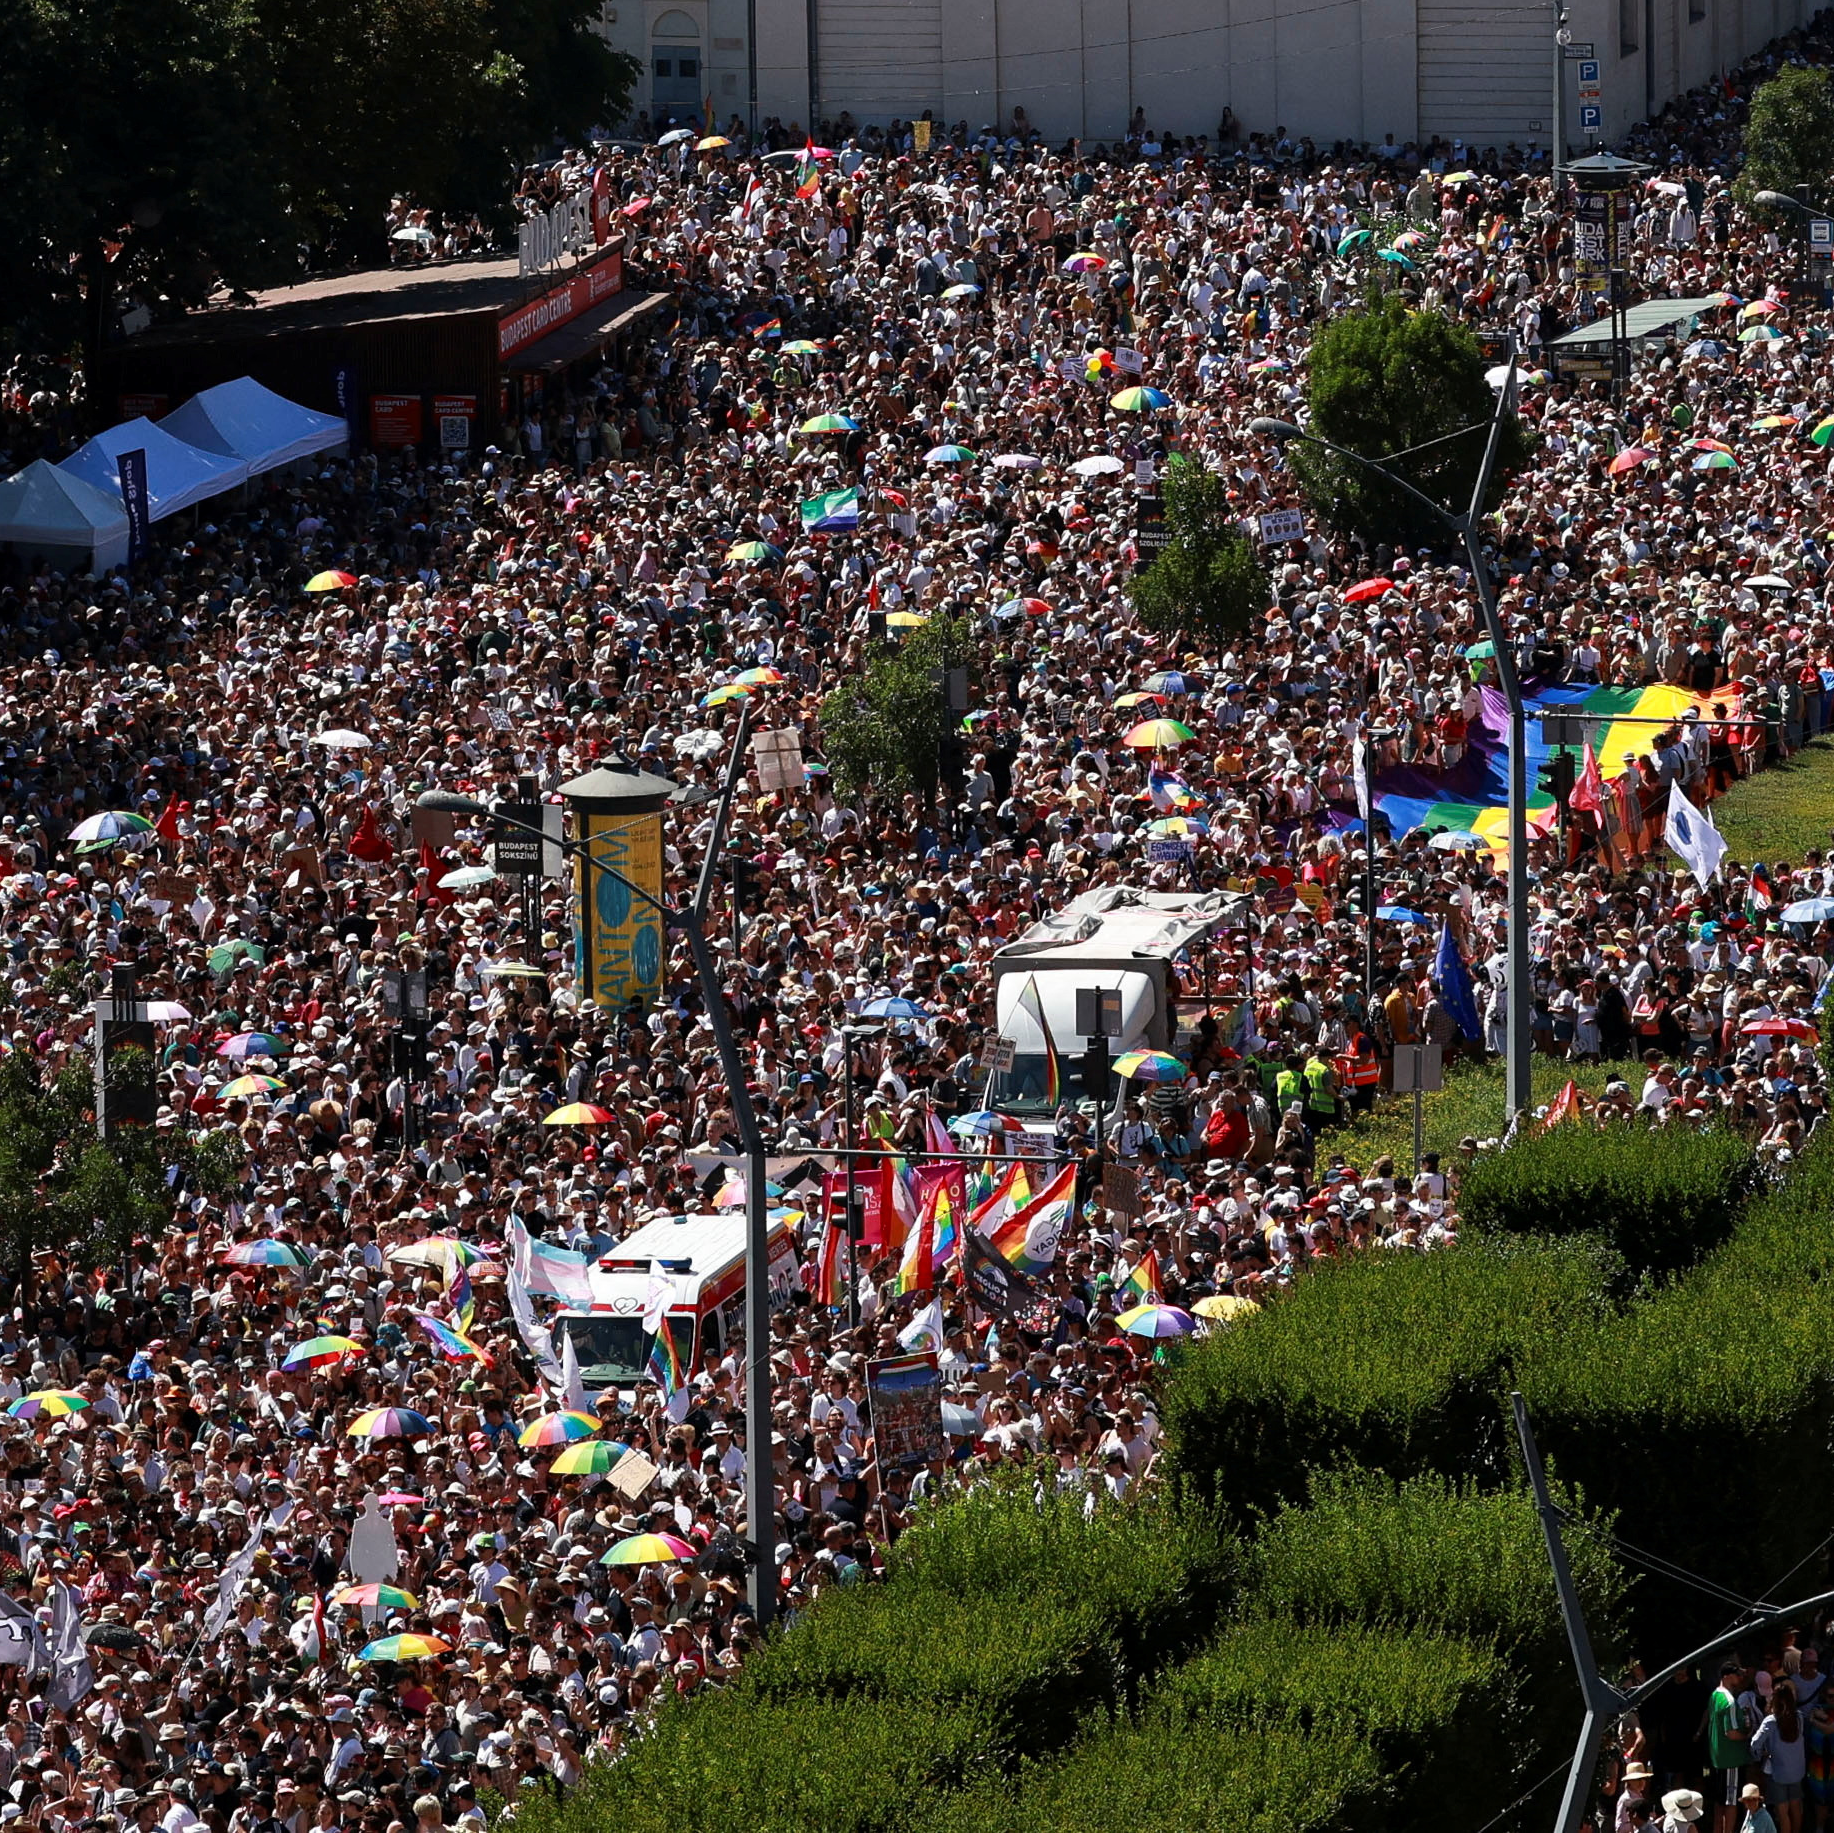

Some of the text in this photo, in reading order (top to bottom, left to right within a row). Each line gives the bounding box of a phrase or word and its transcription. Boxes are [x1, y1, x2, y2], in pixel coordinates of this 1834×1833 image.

[1583, 66, 1595, 79] P
[1585, 109, 1596, 125] P
[499, 291, 572, 354] BUDAPEST CARD CENTRE
[498, 842, 539, 852] BUDAPEST
